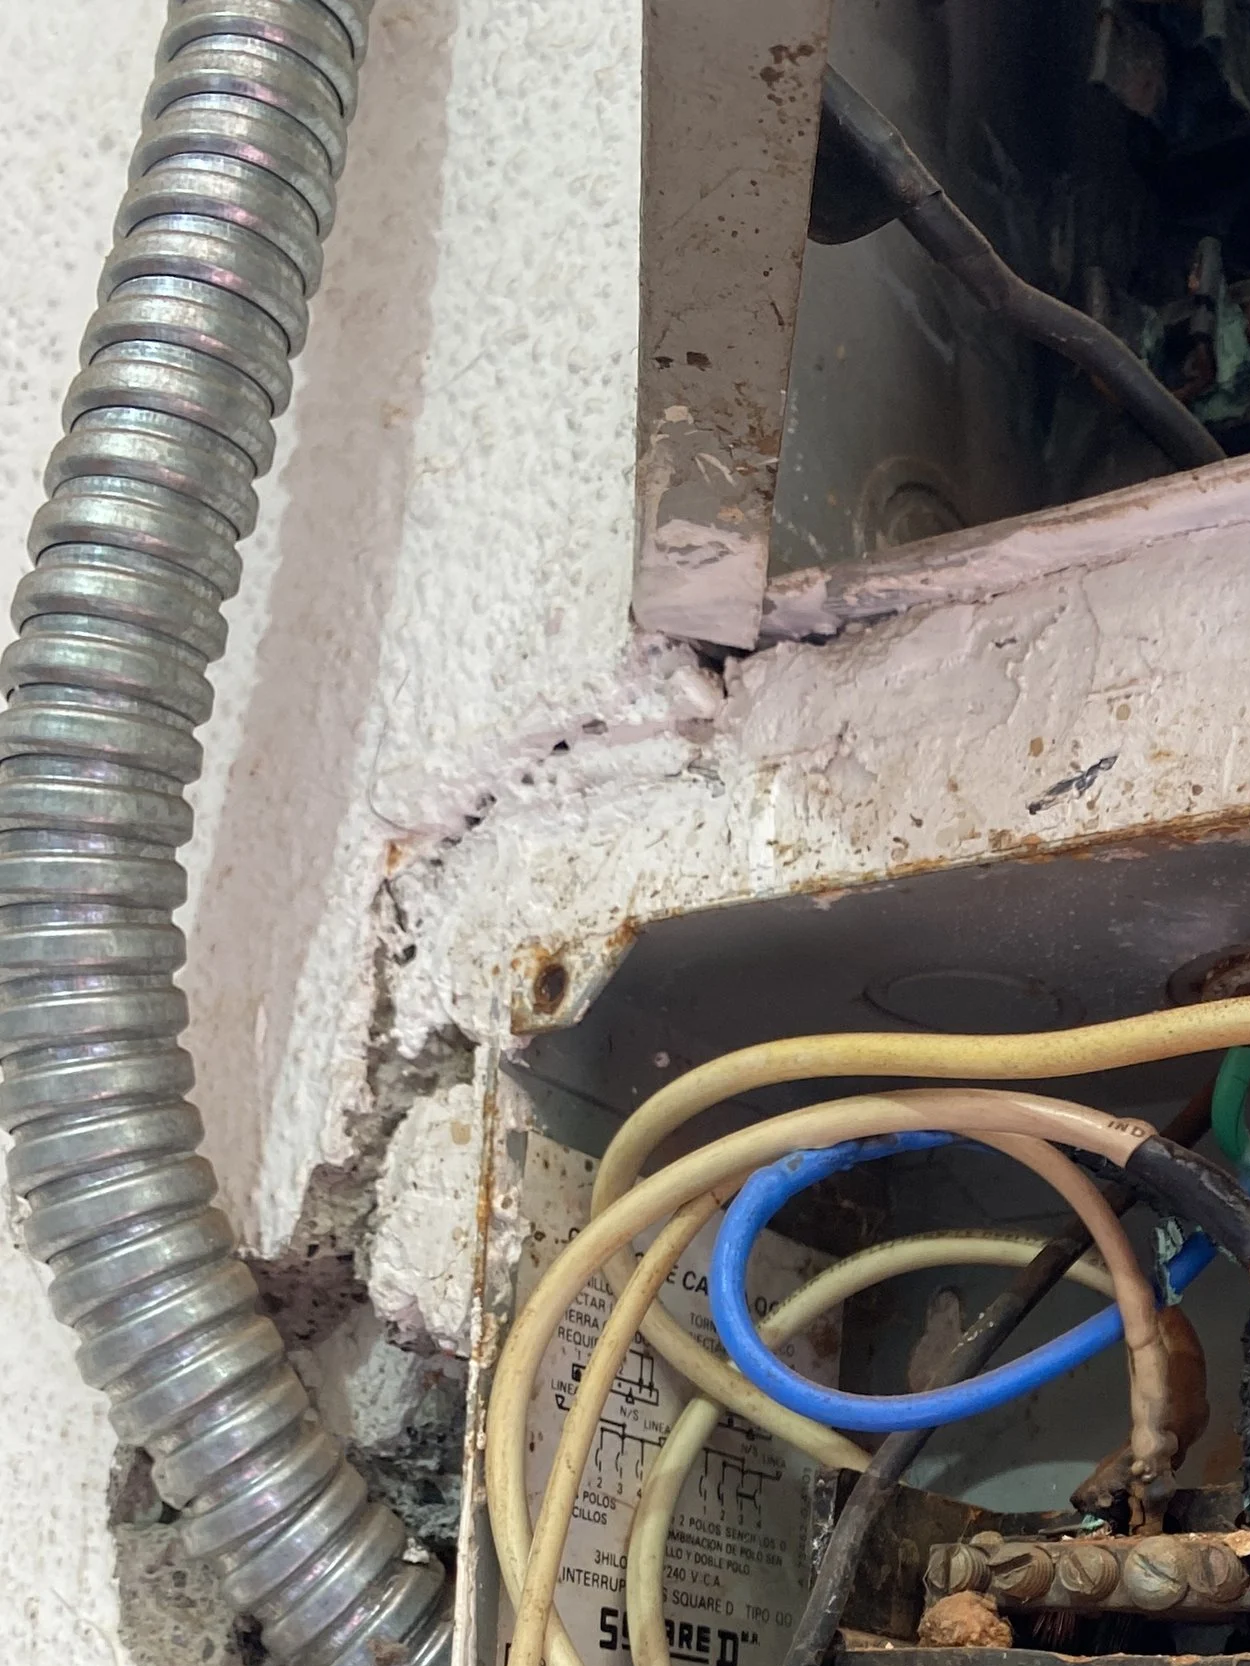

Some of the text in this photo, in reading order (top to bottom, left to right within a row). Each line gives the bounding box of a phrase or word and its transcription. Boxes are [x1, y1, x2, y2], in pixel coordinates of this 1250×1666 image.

[1107, 1121, 1146, 1138] IND
[564, 1308, 600, 1331] IERRA
[620, 1406, 640, 1422] N/S
[596, 1476, 603, 1489] 2
[616, 1482, 623, 1495] 3
[582, 1490, 617, 1511] POLOS
[571, 1506, 608, 1526] CILLOS
[689, 1516, 721, 1537] POLOS
[594, 1549, 628, 1570] 3HILO
[662, 1564, 687, 1582] 240
[665, 1545, 683, 1560] LLO
[726, 1559, 751, 1576] POLO
[671, 1589, 722, 1614] SQUARE
[725, 1601, 734, 1616] D
[745, 1604, 770, 1623] TIPO
